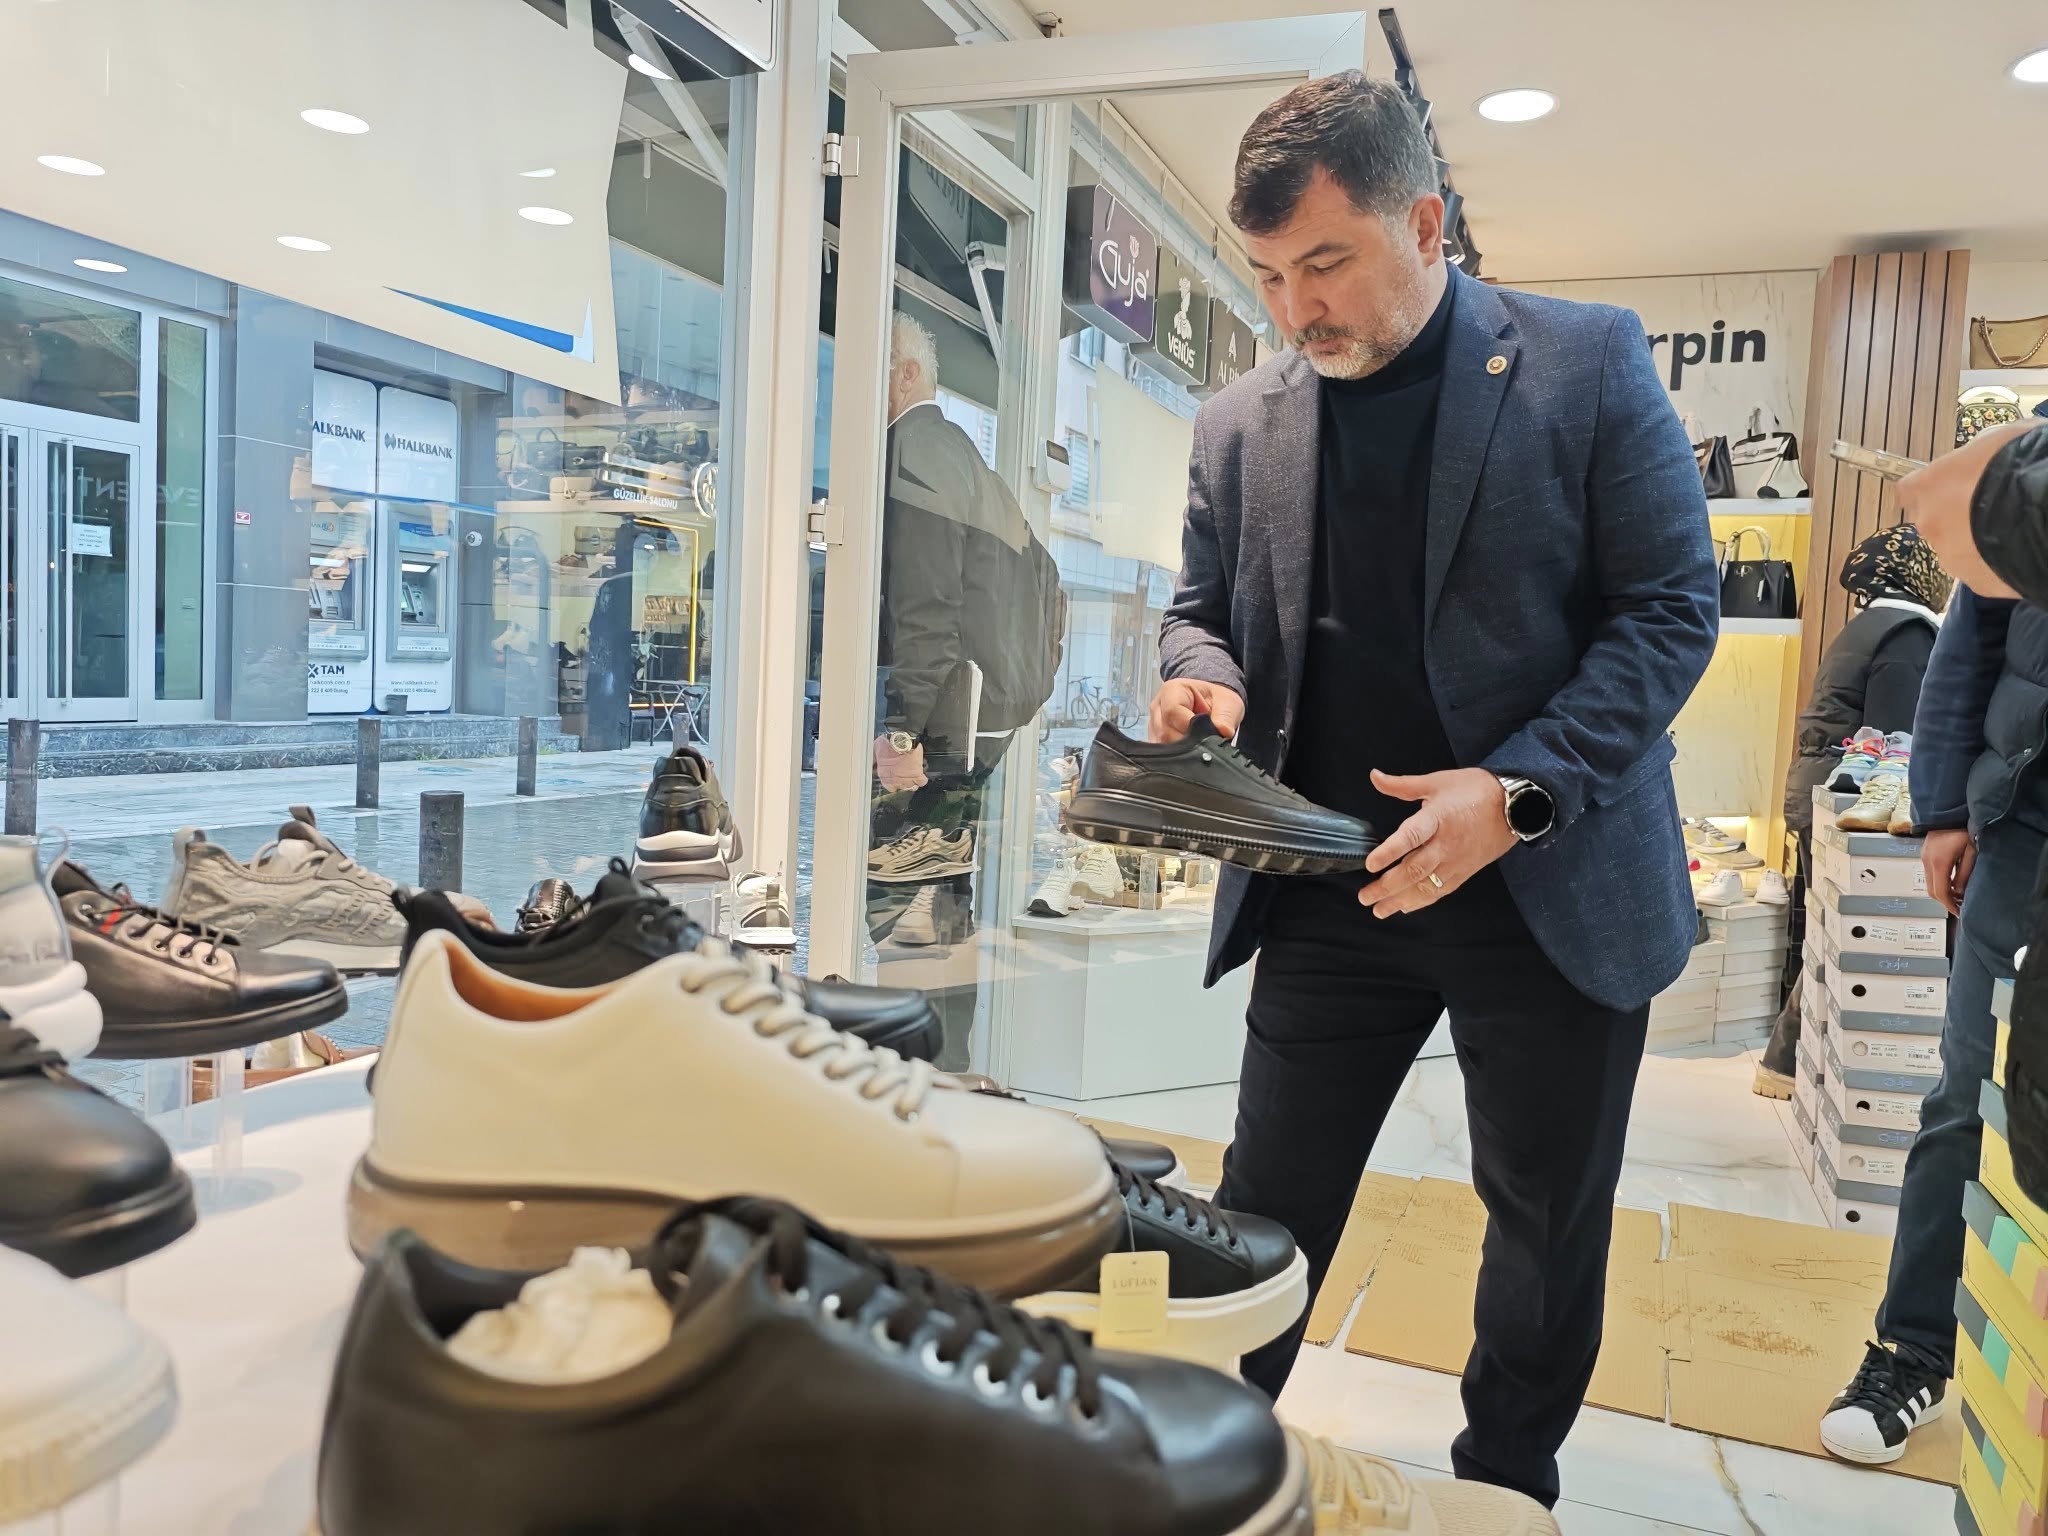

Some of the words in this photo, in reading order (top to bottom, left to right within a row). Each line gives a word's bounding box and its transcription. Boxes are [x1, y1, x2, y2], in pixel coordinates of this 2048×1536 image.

[1099, 239, 1148, 307] Guja
[397, 437, 453, 460] HALKBANK
[648, 496, 678, 510] SALONU
[321, 665, 345, 675] TAM
